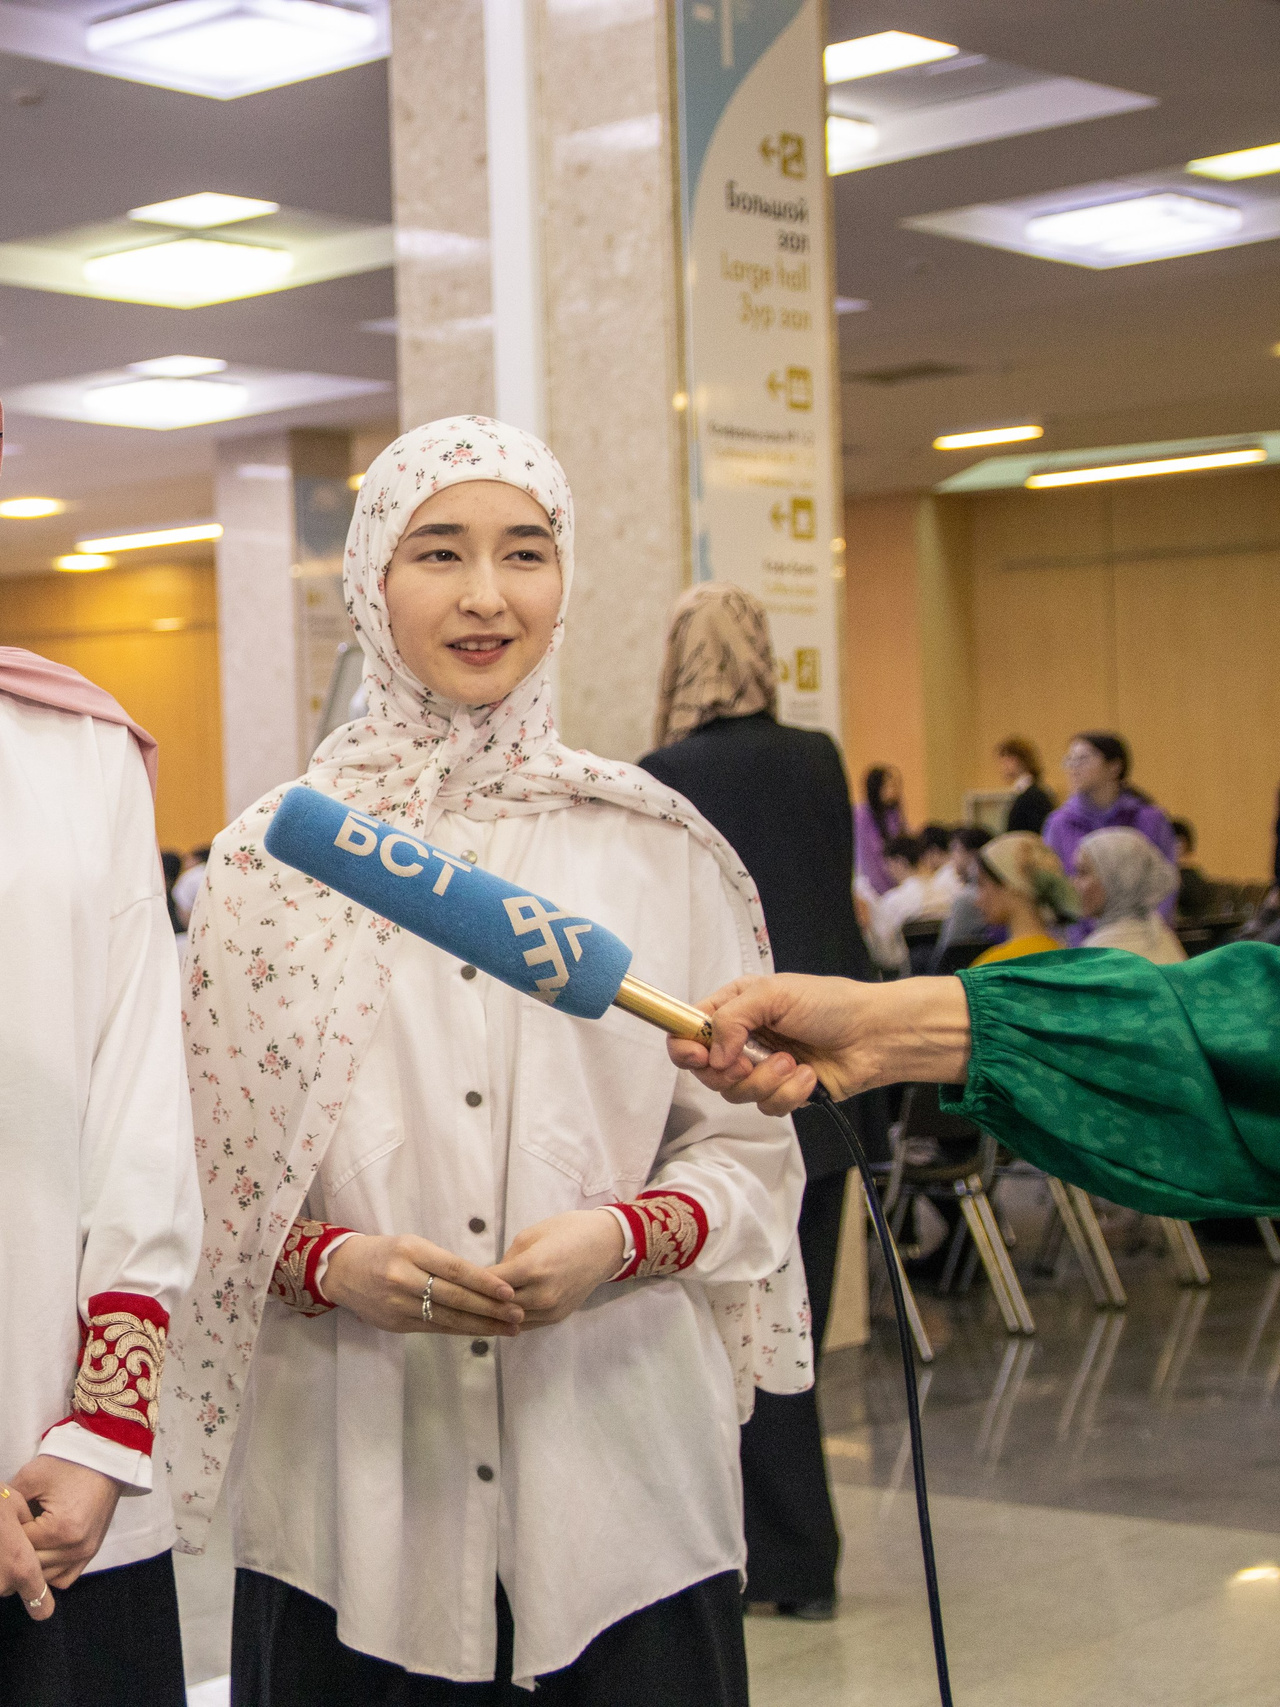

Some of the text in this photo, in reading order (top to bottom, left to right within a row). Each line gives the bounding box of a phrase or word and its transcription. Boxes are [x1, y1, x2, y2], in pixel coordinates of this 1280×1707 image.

[726, 180, 810, 223] Большой
[778, 228, 810, 254] зал
[721, 250, 811, 293] Large hall
[333, 810, 472, 897] БСТ
